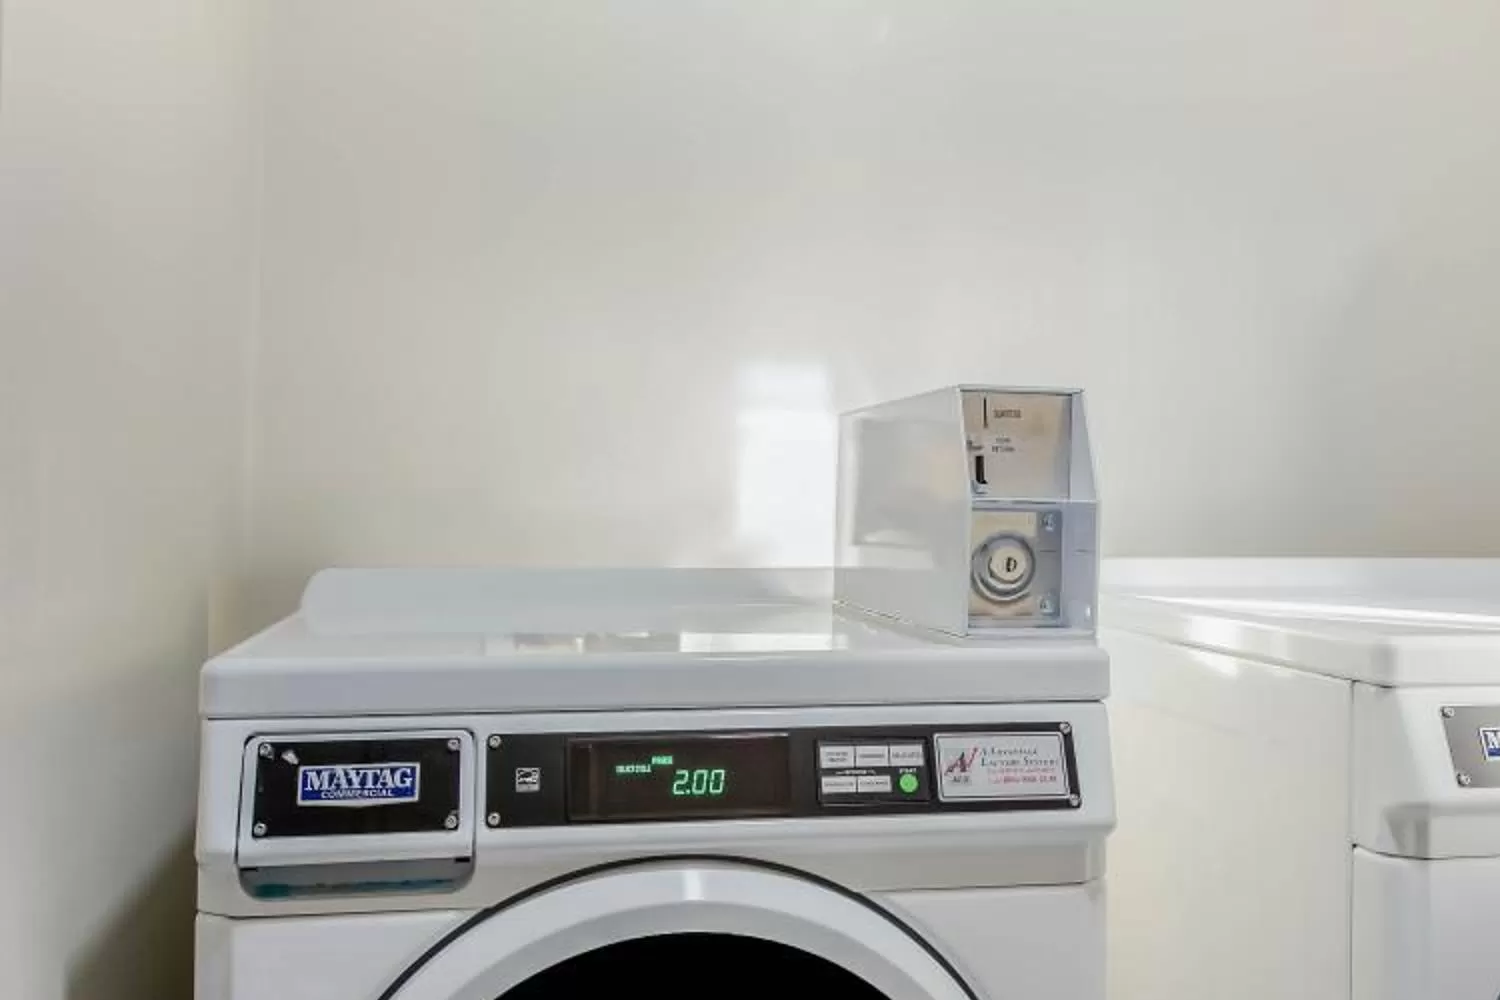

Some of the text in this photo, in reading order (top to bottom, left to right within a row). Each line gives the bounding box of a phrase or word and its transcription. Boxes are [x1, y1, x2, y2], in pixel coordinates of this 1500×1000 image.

[304, 767, 413, 791] MAYTAG
[672, 769, 726, 795] 2.00
[320, 788, 394, 799] COMMERCIAL
